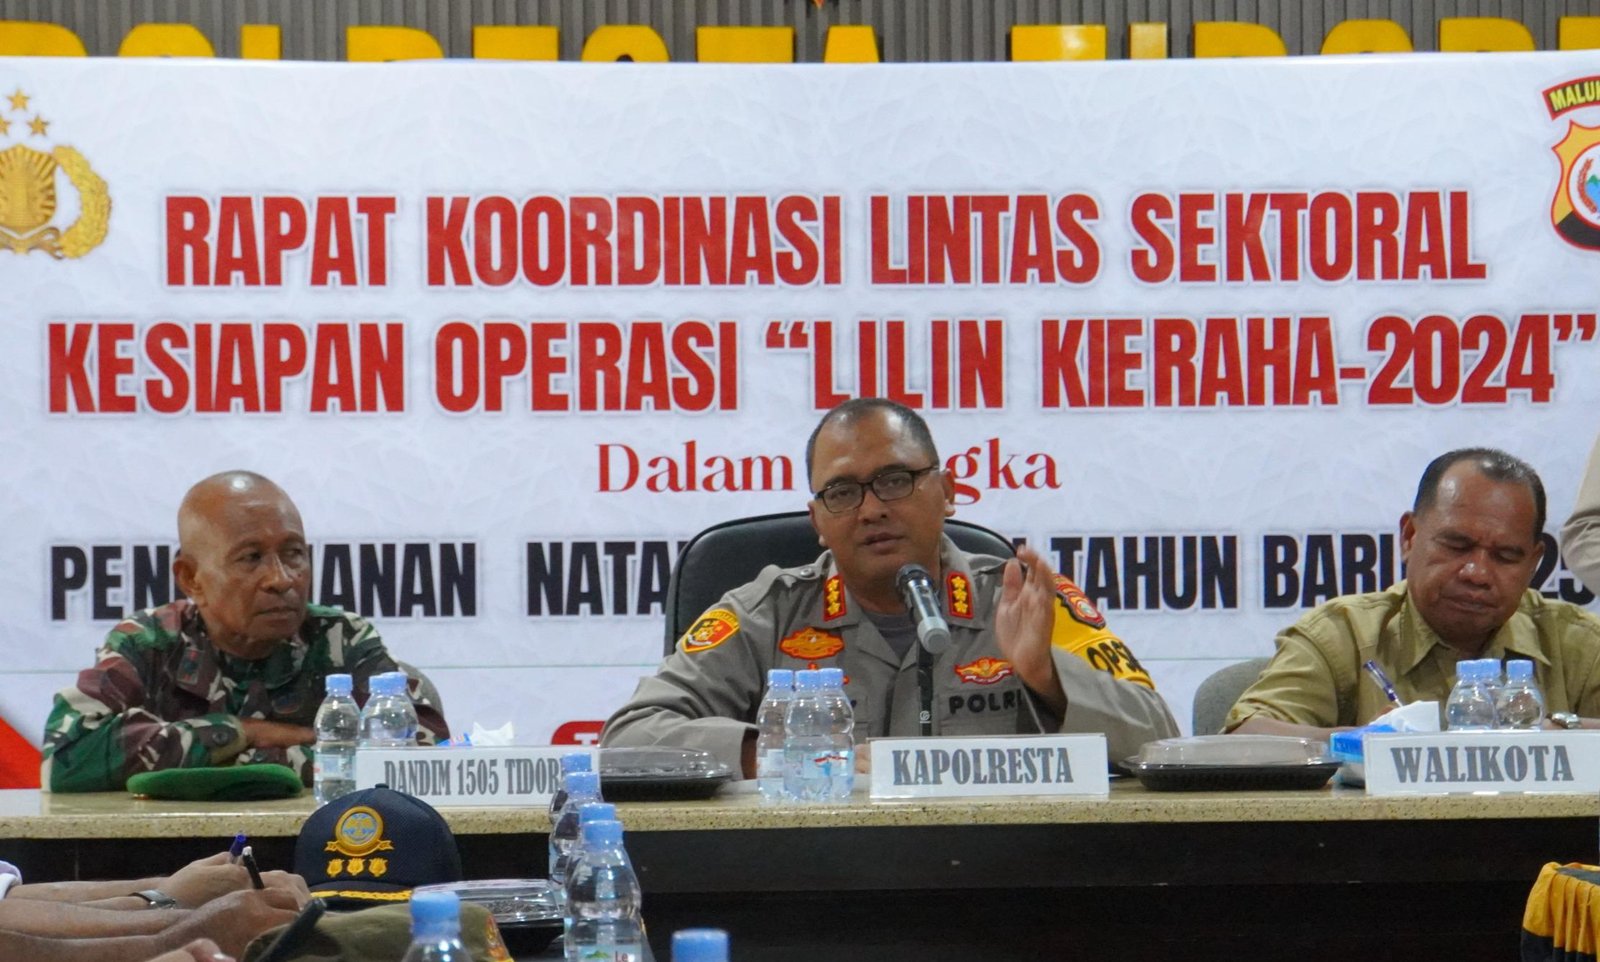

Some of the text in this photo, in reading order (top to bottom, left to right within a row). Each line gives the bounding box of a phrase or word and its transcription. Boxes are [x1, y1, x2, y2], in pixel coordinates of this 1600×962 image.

[1550, 80, 1600, 112] MALU
[165, 190, 1488, 287] RAPAT KOORDINASI LINTAS SEKTORAL
[48, 322, 405, 414] KESIAPAN
[434, 321, 738, 412] OPERASI
[595, 439, 797, 492] Dalam
[51, 542, 477, 620] PENANAN
[526, 540, 692, 616] NATA
[1050, 534, 1239, 611] TAHUN
[948, 689, 1022, 715] POLRI
[384, 757, 564, 796] DANDIM 1505 TIDOR
[891, 747, 1075, 786] KAPOLRESTA
[1390, 744, 1576, 784] WALIKOTA
